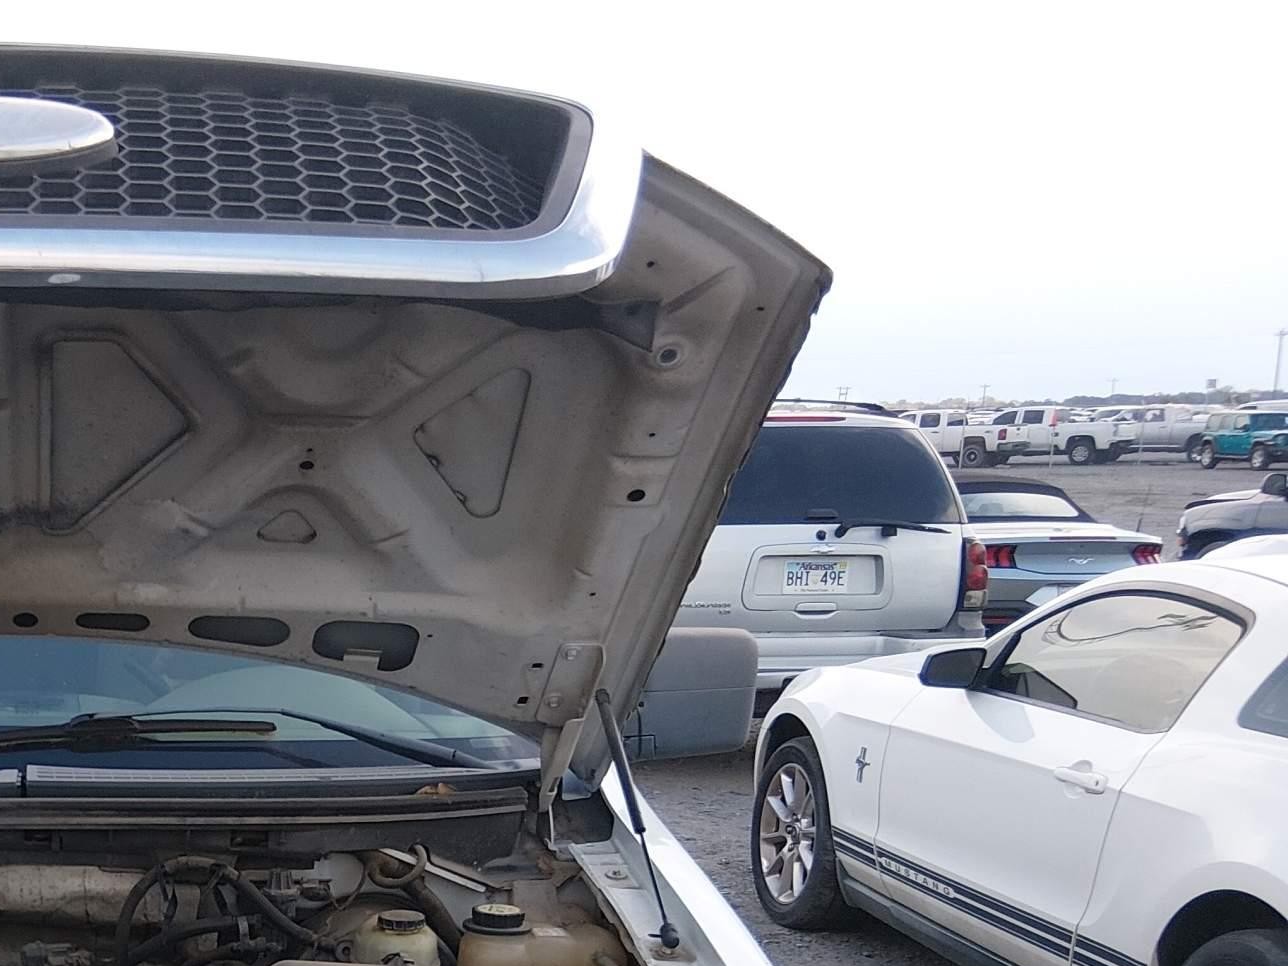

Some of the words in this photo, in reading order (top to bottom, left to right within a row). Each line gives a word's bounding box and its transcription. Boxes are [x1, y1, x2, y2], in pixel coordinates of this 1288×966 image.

[798, 562, 835, 571] Arkansas
[786, 570, 810, 587] BHI
[820, 570, 846, 587] 49E
[884, 858, 951, 896] MUSTANG
